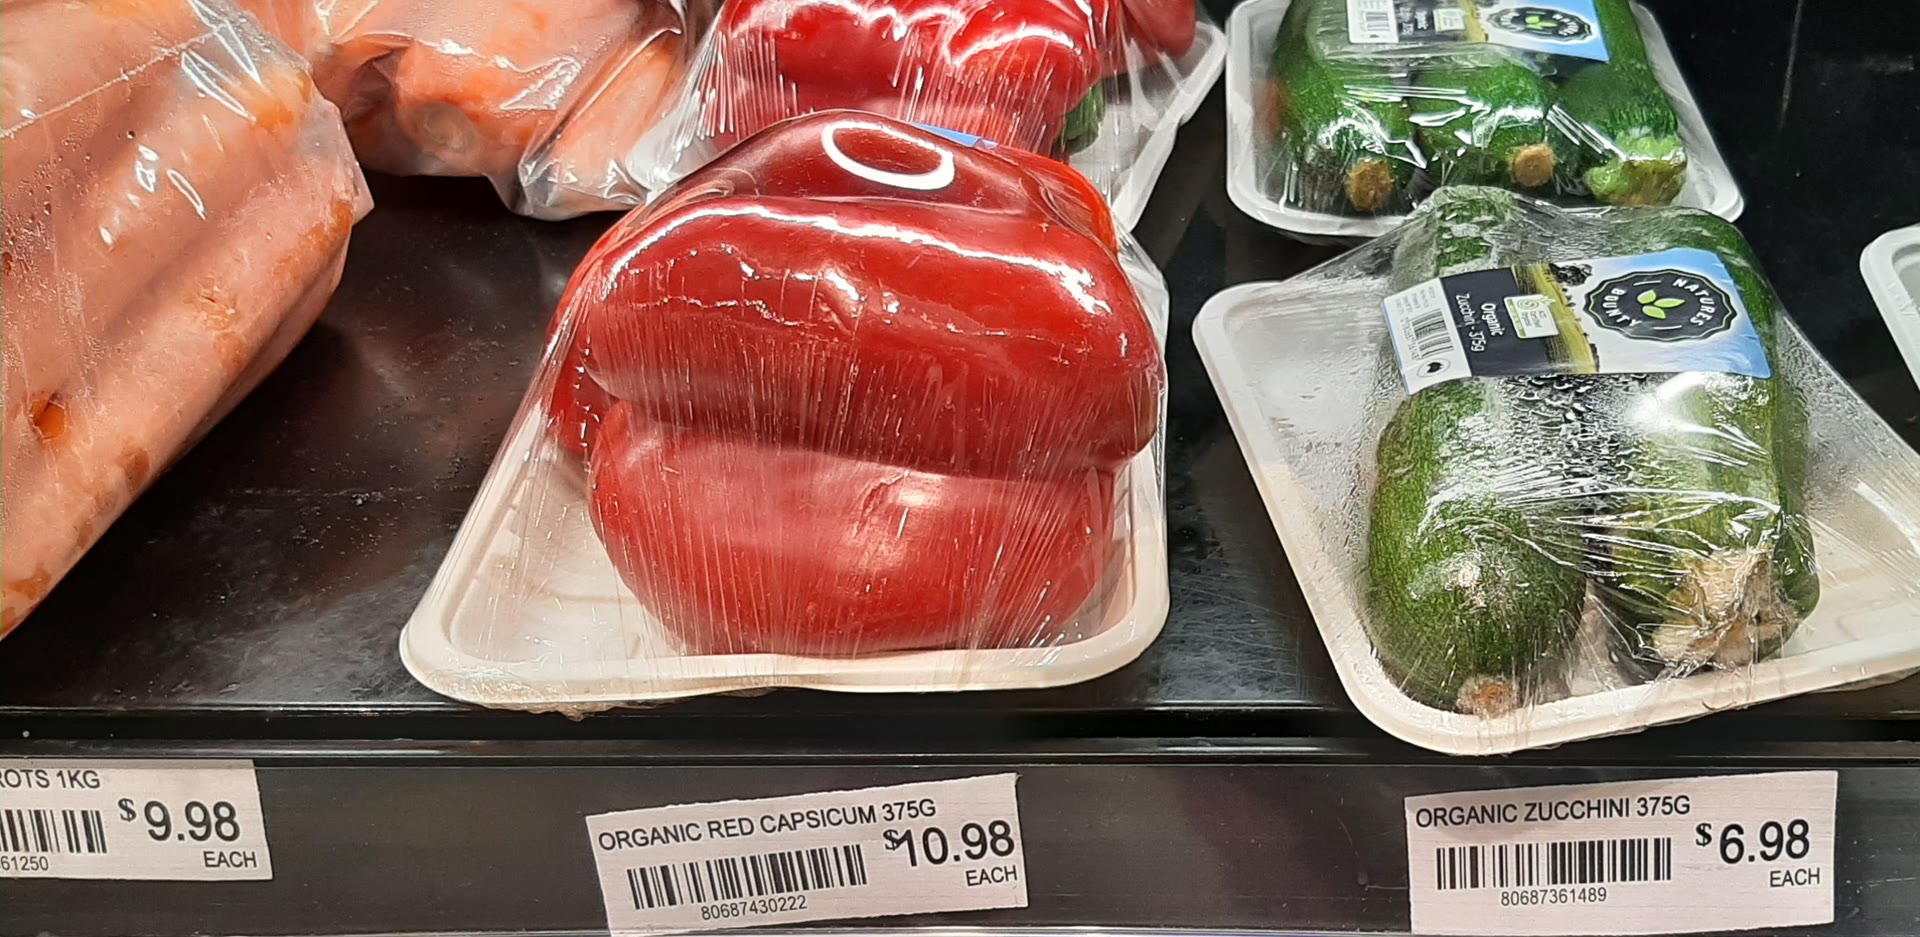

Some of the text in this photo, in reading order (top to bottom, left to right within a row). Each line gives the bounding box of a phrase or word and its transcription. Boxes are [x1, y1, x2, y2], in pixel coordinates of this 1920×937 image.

[1602, 278, 1716, 327] NATURES BOUNTY
[1480, 302, 1505, 337] Organic
[1469, 331, 1487, 352] 375g
[0, 768, 101, 789] OTS 1KG
[1415, 794, 1691, 828] ORGANIC ZUCCHINI 375G
[598, 797, 937, 851] ORGANIC RED CAPSICUM 375G
[882, 819, 1015, 867] $10.98
[203, 850, 258, 868] EACH
[965, 864, 1018, 887] EACH
[1769, 867, 1821, 888] EACH
[700, 894, 808, 921] 80687430222
[1500, 886, 1608, 907] 80687361489
